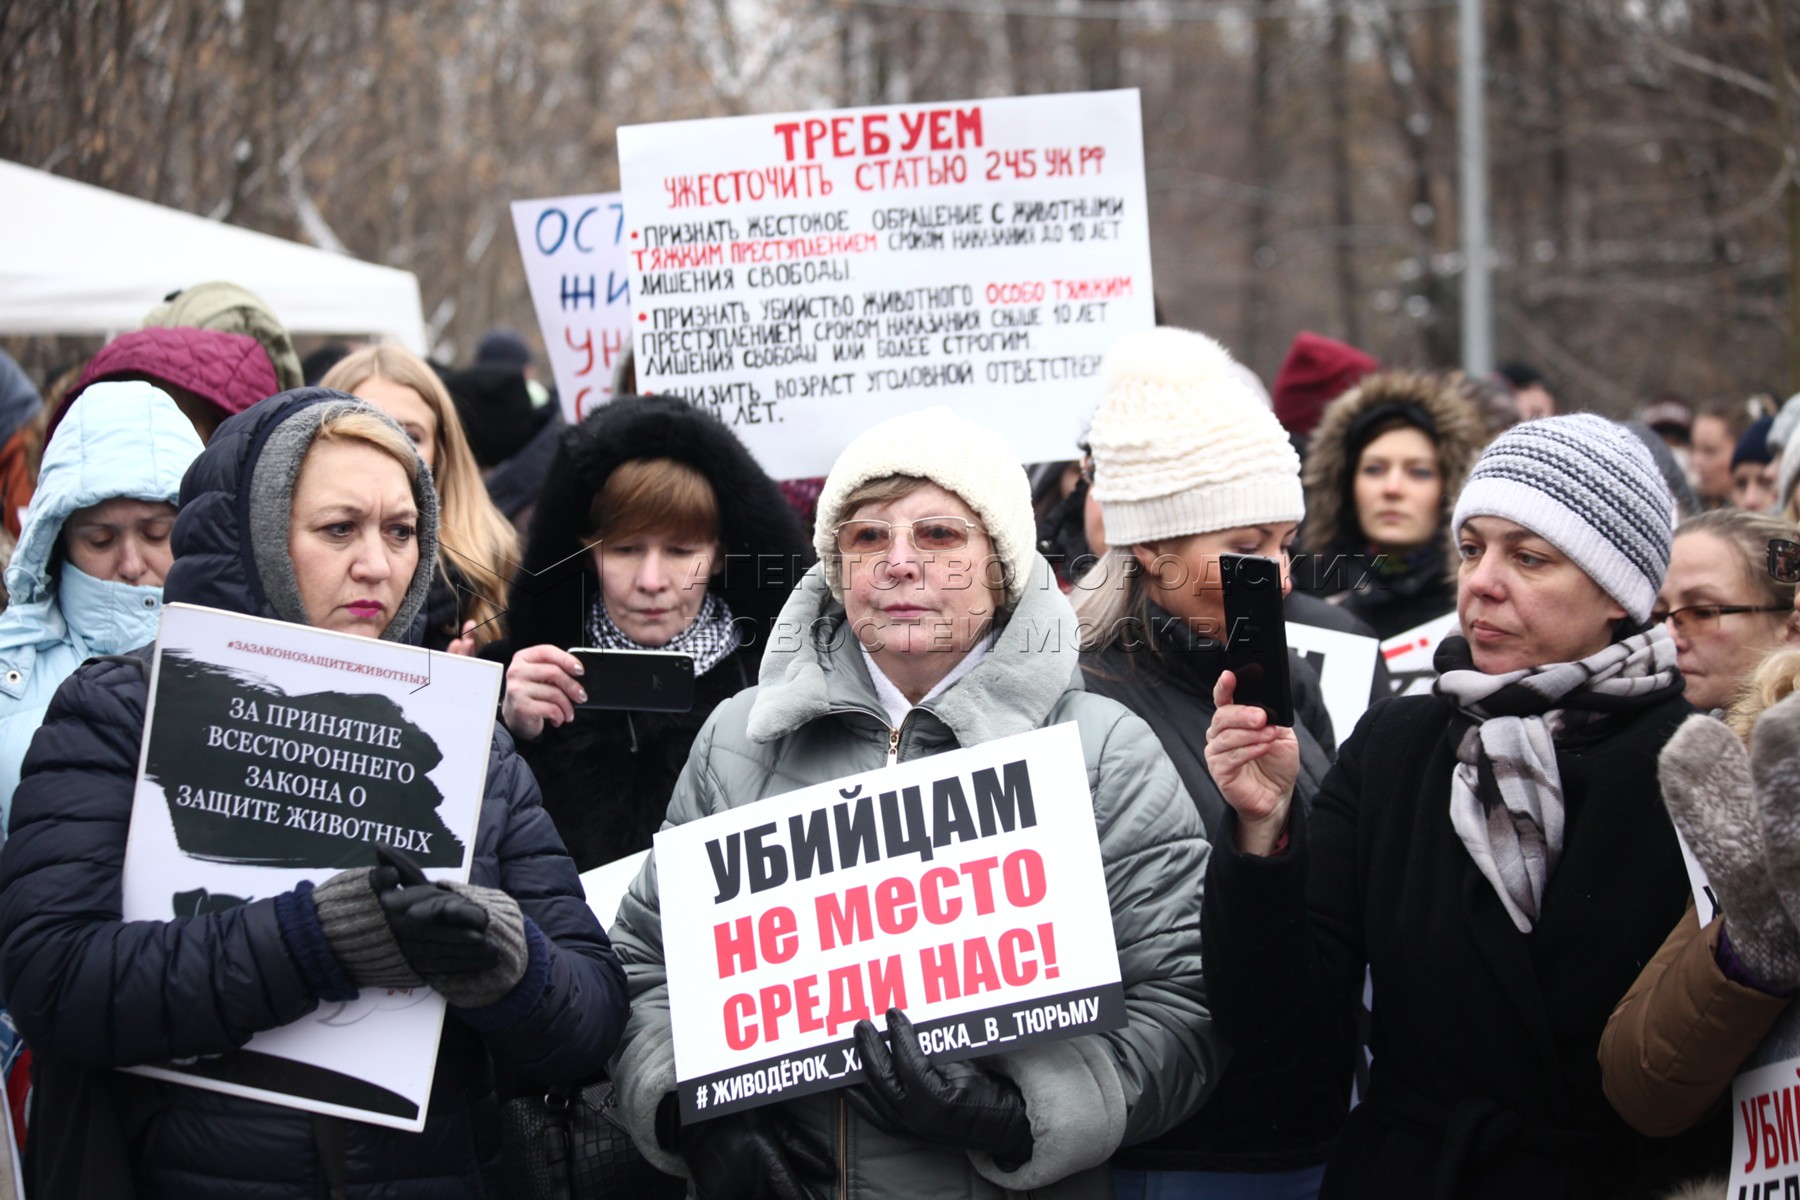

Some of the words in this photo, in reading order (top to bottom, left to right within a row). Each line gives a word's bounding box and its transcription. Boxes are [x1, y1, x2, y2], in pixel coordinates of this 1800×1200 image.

[774, 107, 983, 161] ТРЕБУЕМ
[664, 164, 833, 208] УЖЕСТОЧИТЬ
[855, 154, 967, 191] СТАТЬЮ
[986, 150, 1036, 180] 245
[1045, 148, 1072, 177] УК
[1080, 147, 1105, 176] РФ
[632, 244, 724, 272] ТЯЖКИМ
[731, 232, 877, 264] ПРЕСТУПЛЕНИЕМ
[888, 230, 945, 251] СРОКОМ
[952, 224, 1036, 249] НАКАЗАНИЯ
[1041, 224, 1063, 243] ДО
[1069, 222, 1085, 242] 10
[1090, 220, 1121, 241] ЛЕТ
[644, 218, 740, 249] ПРИЗНАТЬ
[748, 210, 849, 238] ЖЕСТОКОЕ
[872, 203, 982, 231] ОБРАЩЕНИЕ
[991, 202, 1004, 224] С
[1012, 197, 1125, 223] ЖИВОТНЫМИ
[640, 268, 735, 296] ЛИШЕНИЯ
[653, 301, 750, 330] ПРИЗНАТЬ
[760, 294, 853, 321] УБИЙСТВО
[863, 285, 973, 316] ЖИВОТНОГО
[985, 281, 1046, 305] ОСОБО
[1052, 275, 1134, 301] ТЯЖКИМ
[642, 321, 801, 356] ПРЕСТУПЛЕНИЕМ
[814, 318, 879, 342] СРОКОМ
[887, 310, 980, 338] НАКАЗАНИЯ
[991, 306, 1042, 329] СВЫШЕ
[1053, 305, 1071, 325] 10
[1076, 302, 1108, 323] ЛЕТ
[645, 348, 734, 376] ЛИШЕНИЯ
[743, 342, 818, 369] СВОБОДЫ
[833, 342, 864, 363] ИЛИ
[877, 336, 930, 359] БОЛЕЕ
[775, 372, 856, 400] ВОЗРАСТ
[867, 361, 974, 393] УГОЛОВНОЙ
[733, 401, 783, 426] ЛЕТ.
[227, 639, 430, 686] #ЗАЗАКОНОЗАЩИТЕЖИВОТНЫХ
[229, 697, 260, 722] ЗА
[265, 704, 402, 750] ПРИНЯТИЕ
[206, 725, 415, 785] ВСЕСТОРОННЕГО
[244, 765, 343, 805] ЗАКОНА
[349, 785, 367, 808] О
[176, 785, 281, 825] ЗАЩИТЕ
[284, 805, 434, 854] ЖИВОТНЫХ
[704, 759, 1037, 905] УБИЙЦАМ
[713, 905, 800, 980] не
[814, 848, 1048, 953] место
[722, 954, 908, 1053] СРЕДИ
[919, 921, 1060, 1005] НАС!
